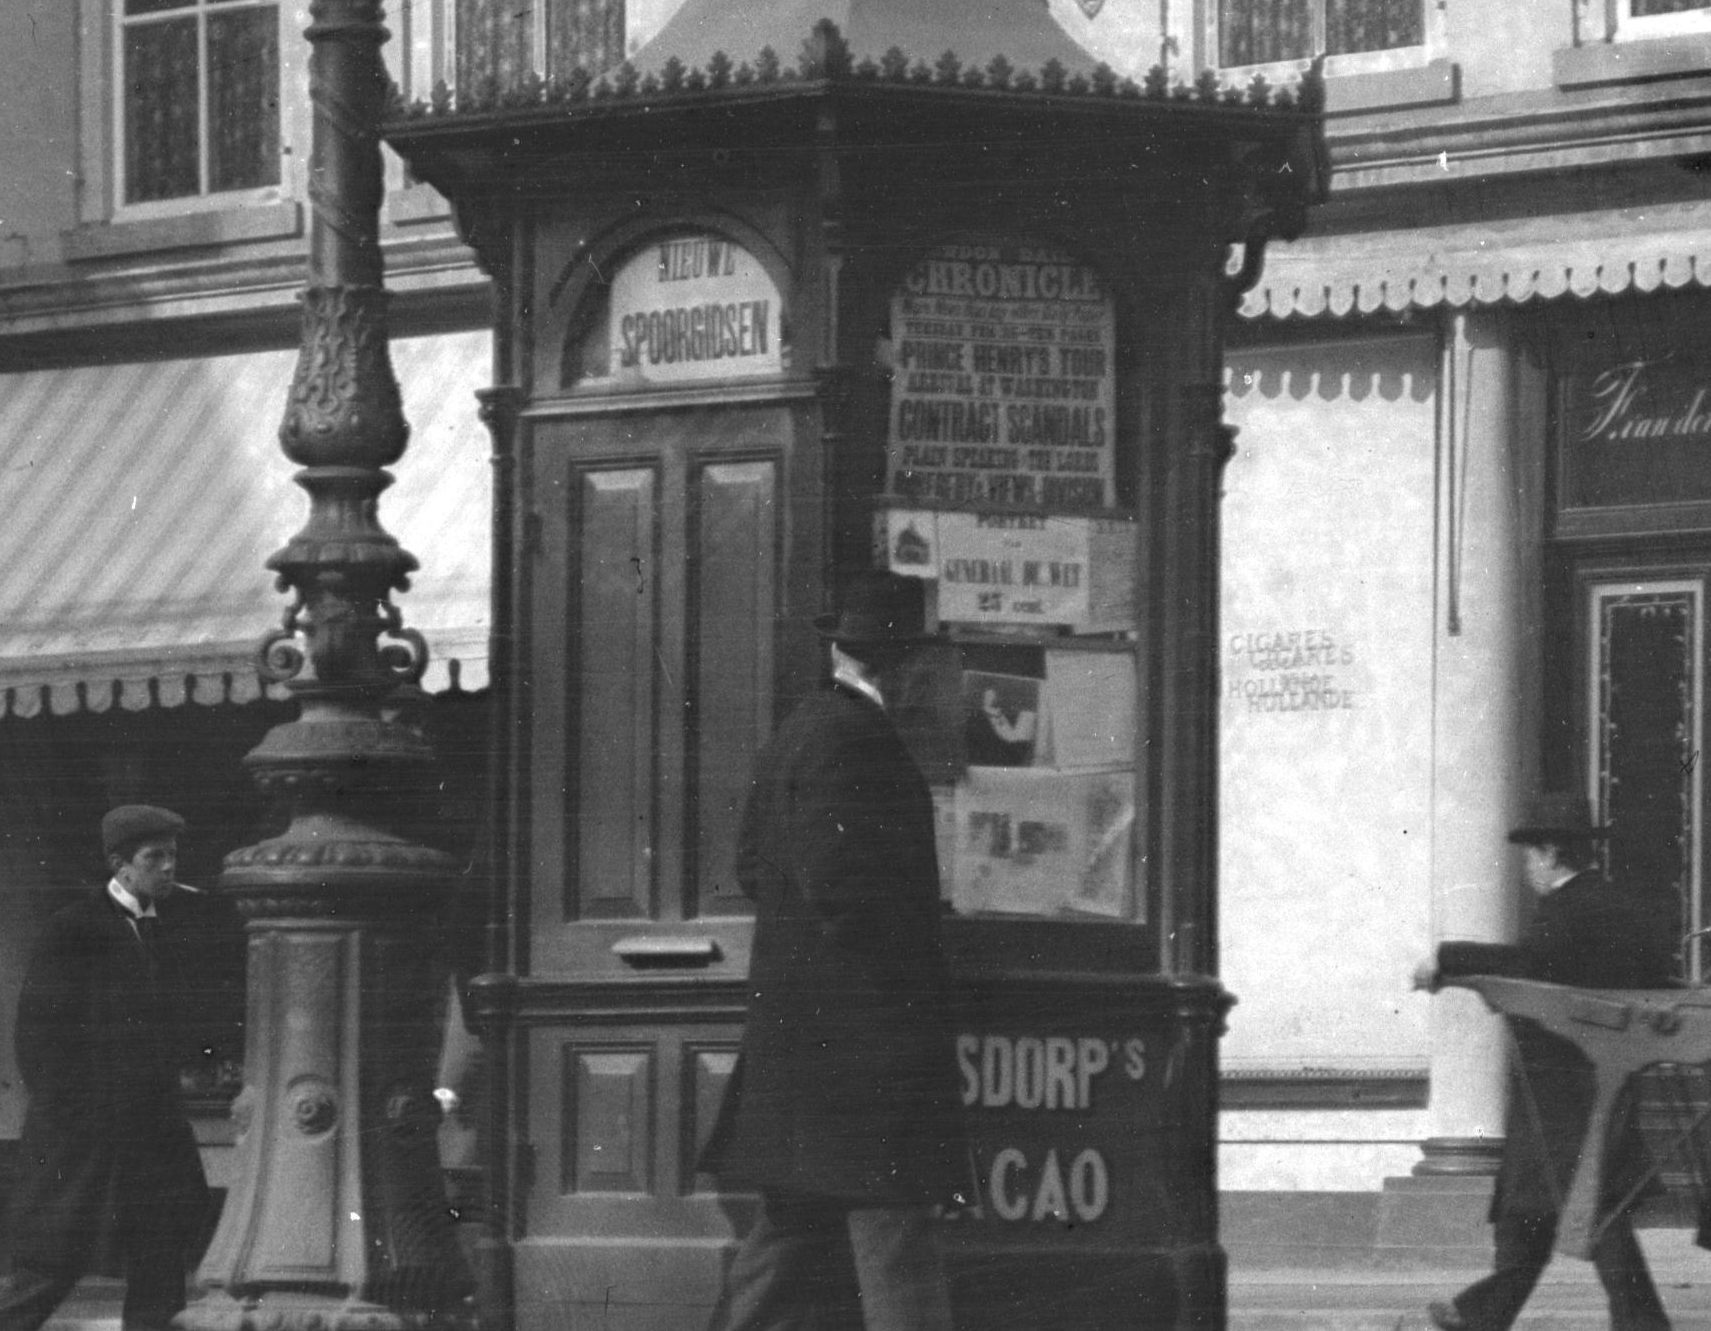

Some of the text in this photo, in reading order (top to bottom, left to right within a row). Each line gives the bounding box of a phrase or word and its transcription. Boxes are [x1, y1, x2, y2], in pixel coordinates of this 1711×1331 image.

[905, 260, 1100, 301] CHRONICLE
[621, 299, 770, 368] SPOORGIDSEN
[902, 340, 1106, 377] PRINCE HENRY'S TOUR
[998, 376, 1100, 400] WASHINGTON
[898, 399, 1106, 448] CONTRACT SCANDALS
[964, 1147, 1109, 1222] CAO
